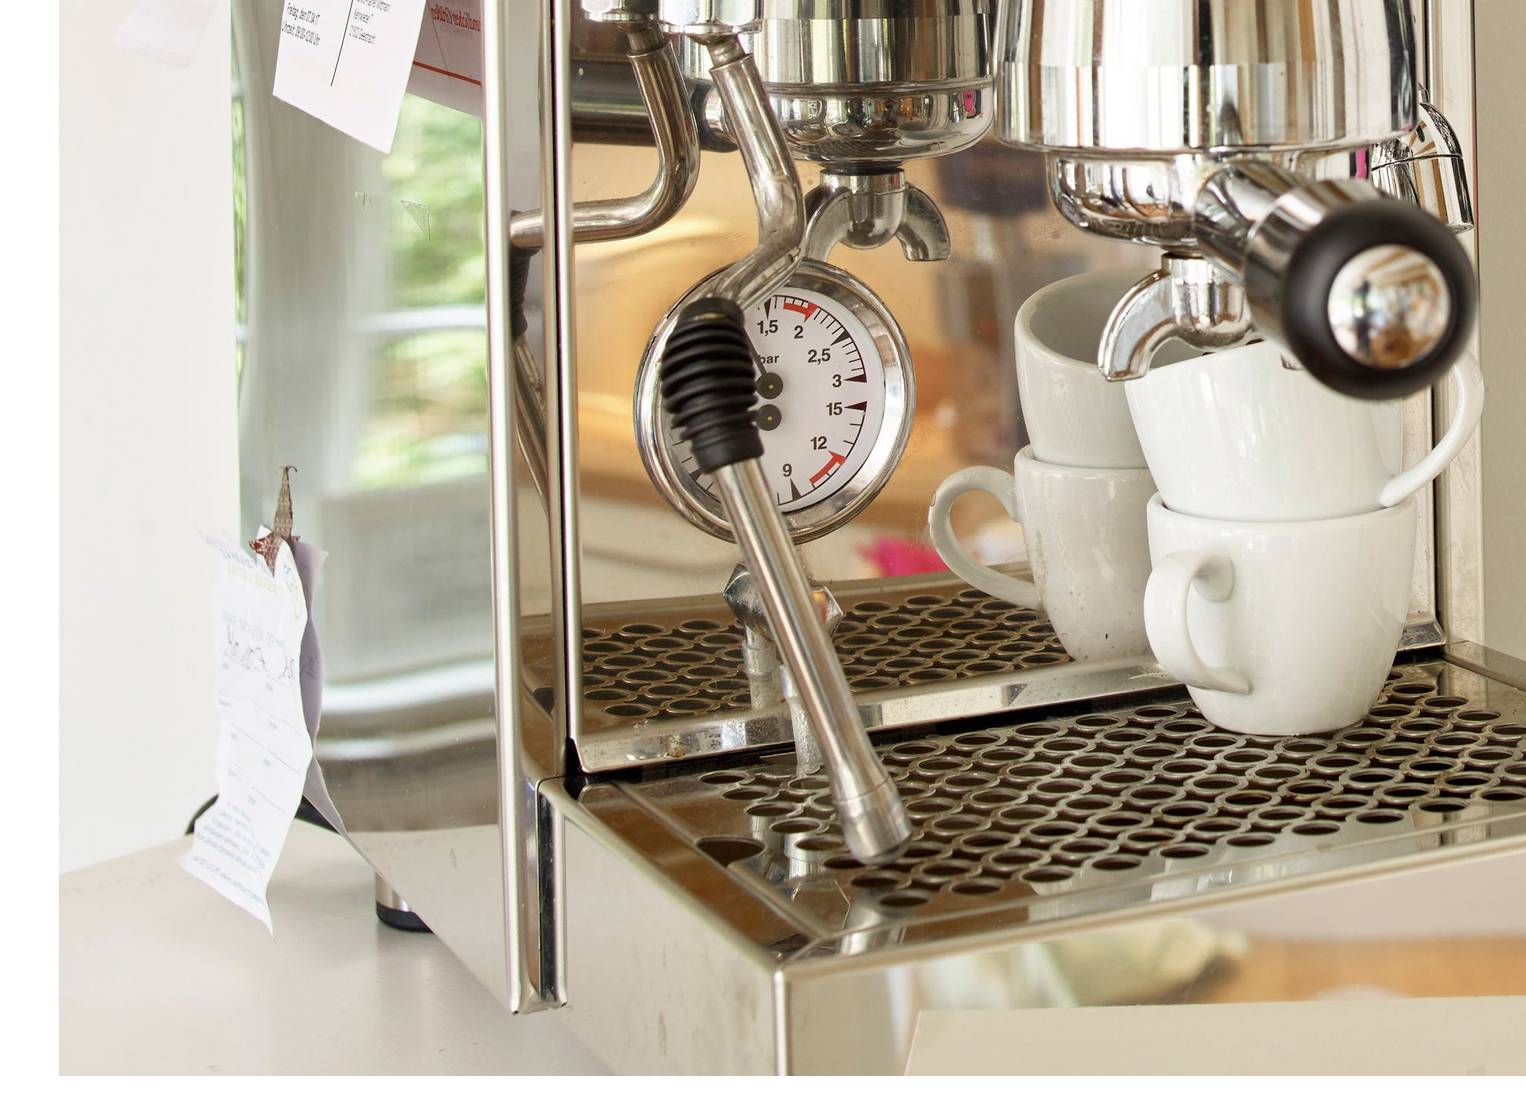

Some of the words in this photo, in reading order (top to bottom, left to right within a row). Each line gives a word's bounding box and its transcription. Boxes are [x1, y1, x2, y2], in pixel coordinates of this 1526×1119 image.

[756, 319, 779, 337] 1,5
[793, 325, 804, 339] 2
[807, 348, 831, 365] 2,5
[831, 373, 843, 388] 3
[825, 401, 844, 416] 15
[810, 436, 828, 451] 12
[782, 463, 793, 478] 9
